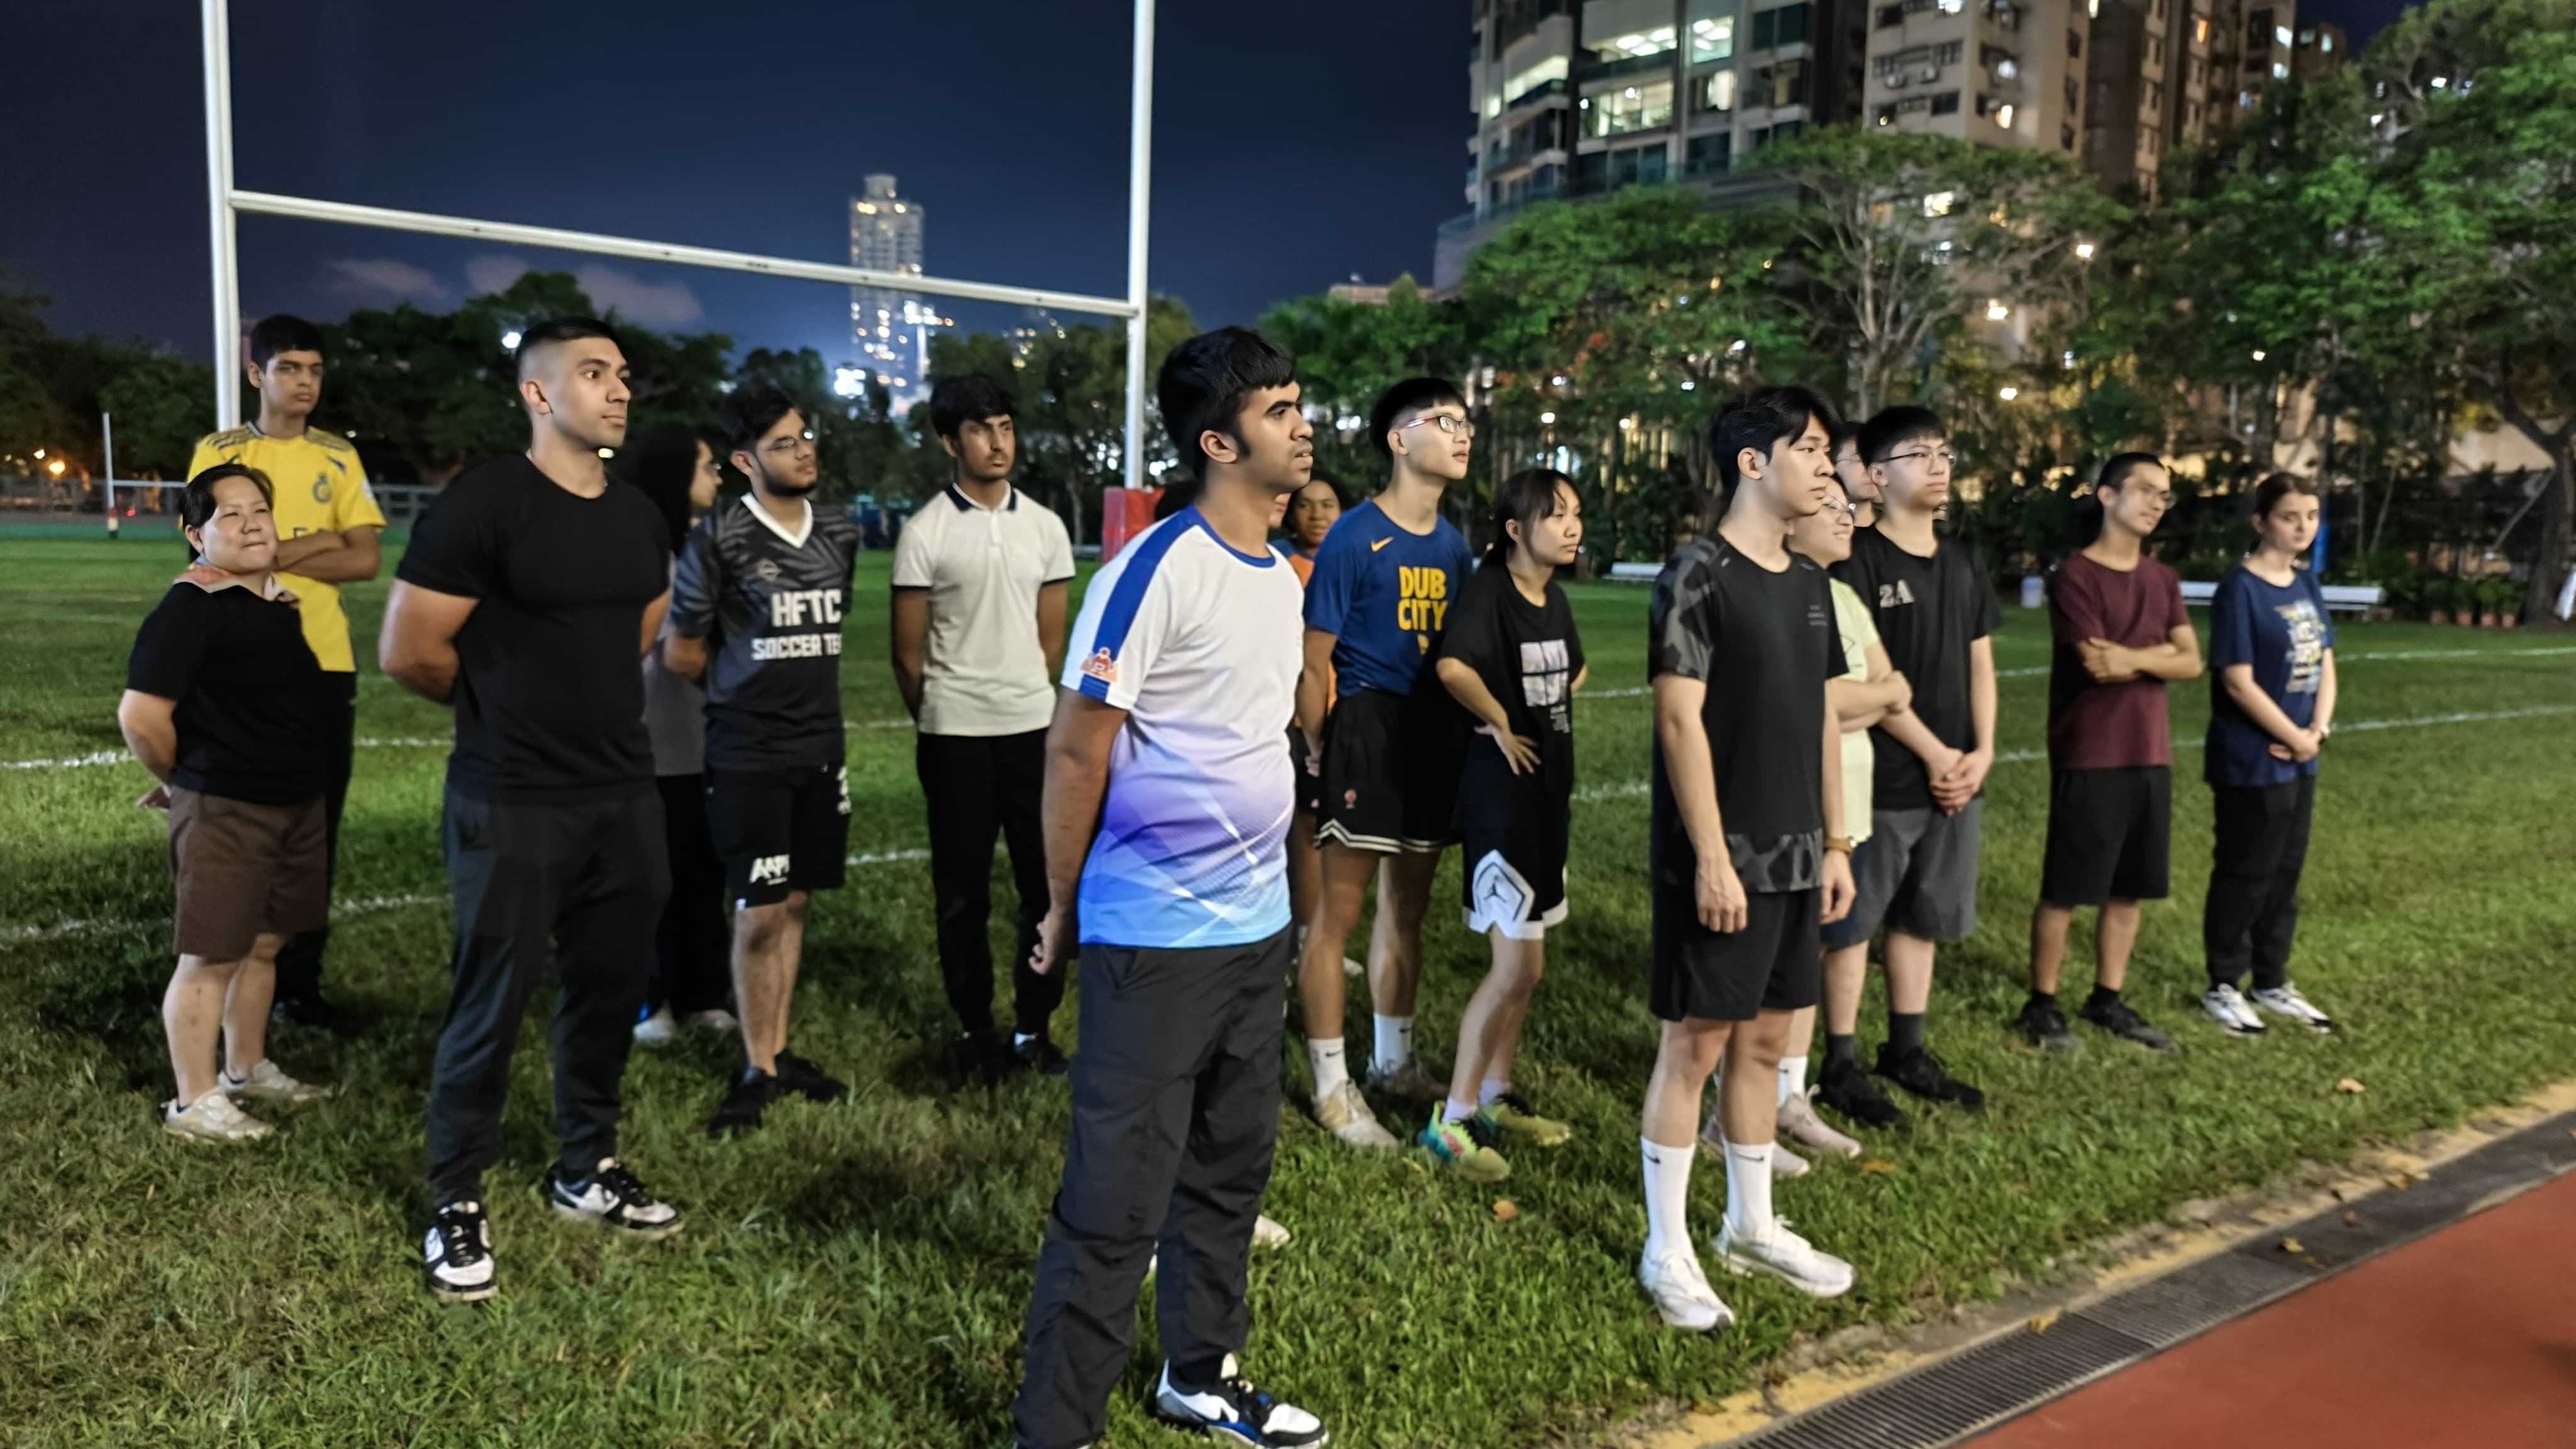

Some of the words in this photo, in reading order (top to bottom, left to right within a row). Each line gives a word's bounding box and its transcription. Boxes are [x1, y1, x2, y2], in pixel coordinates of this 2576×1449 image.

[1399, 565, 1446, 599] DUB
[1879, 579, 1915, 608] 2A
[771, 589, 841, 628] HFTC
[1397, 598, 1448, 631] CITY
[751, 633, 822, 660] SOCCER
